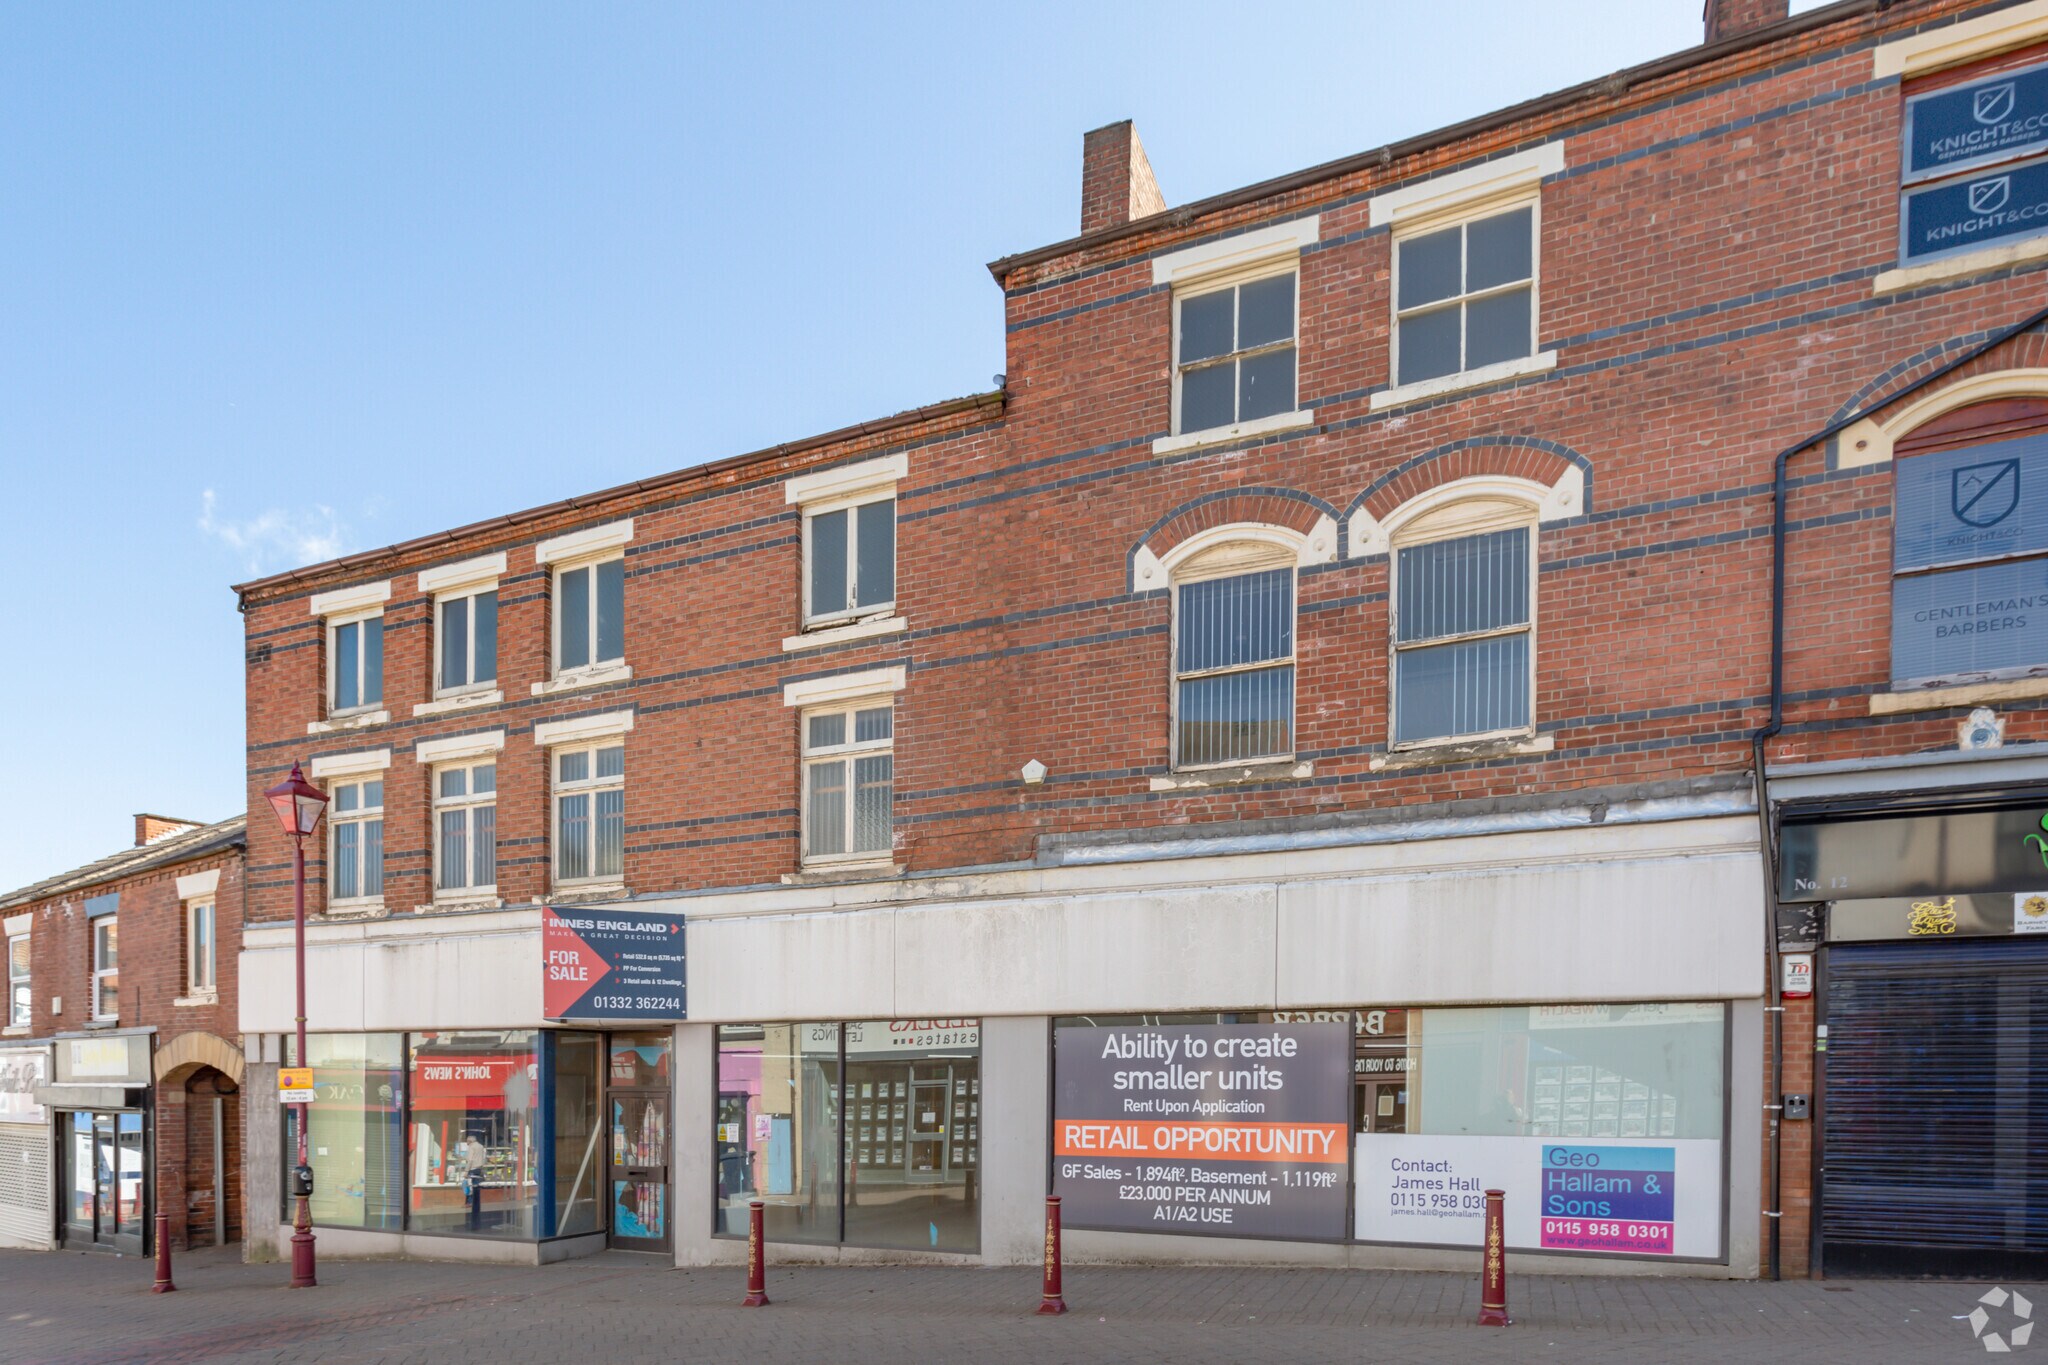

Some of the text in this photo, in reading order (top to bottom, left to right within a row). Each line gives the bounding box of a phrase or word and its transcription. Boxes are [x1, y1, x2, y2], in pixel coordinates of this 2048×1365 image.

[2000, 130, 2040, 146] BARBERS
[1926, 202, 2048, 242] KNIGHT&CO
[1914, 594, 2048, 622] GENTLEMAN'S
[1936, 615, 2027, 638] BARBERS
[1794, 876, 1848, 891] No. 12
[549, 918, 667, 933] INNES ENGLAND
[549, 950, 579, 965] FOR
[549, 966, 588, 981] SALE
[662, 979, 682, 987] Dwellings
[593, 996, 680, 1010] 01332 362244
[1101, 1033, 1298, 1065] Ability to create
[1113, 1064, 1284, 1090] smaller units
[1124, 1098, 1265, 1116] Rent Upon Application
[1065, 1125, 1336, 1154] RETAIL OPPORTUNITY
[1391, 1158, 1452, 1173] Contact:
[1549, 1147, 1600, 1167] Geo
[1062, 1163, 1082, 1178] GF
[1084, 1164, 1122, 1180] Sales
[1191, 1167, 1268, 1185] Basement
[1391, 1175, 1480, 1191] James Hall
[1548, 1171, 1662, 1194] Hallam &
[1119, 1185, 1271, 1206] £23,000 PER ANNUM
[1391, 1192, 1487, 1209] 0115 958 030
[1548, 1194, 1611, 1216] Sons
[1153, 1205, 1233, 1224] A1/A2 USE
[1546, 1221, 1668, 1239] 0115 958 0301
[1547, 1236, 1668, 1249] www.geohallam.co.uk
